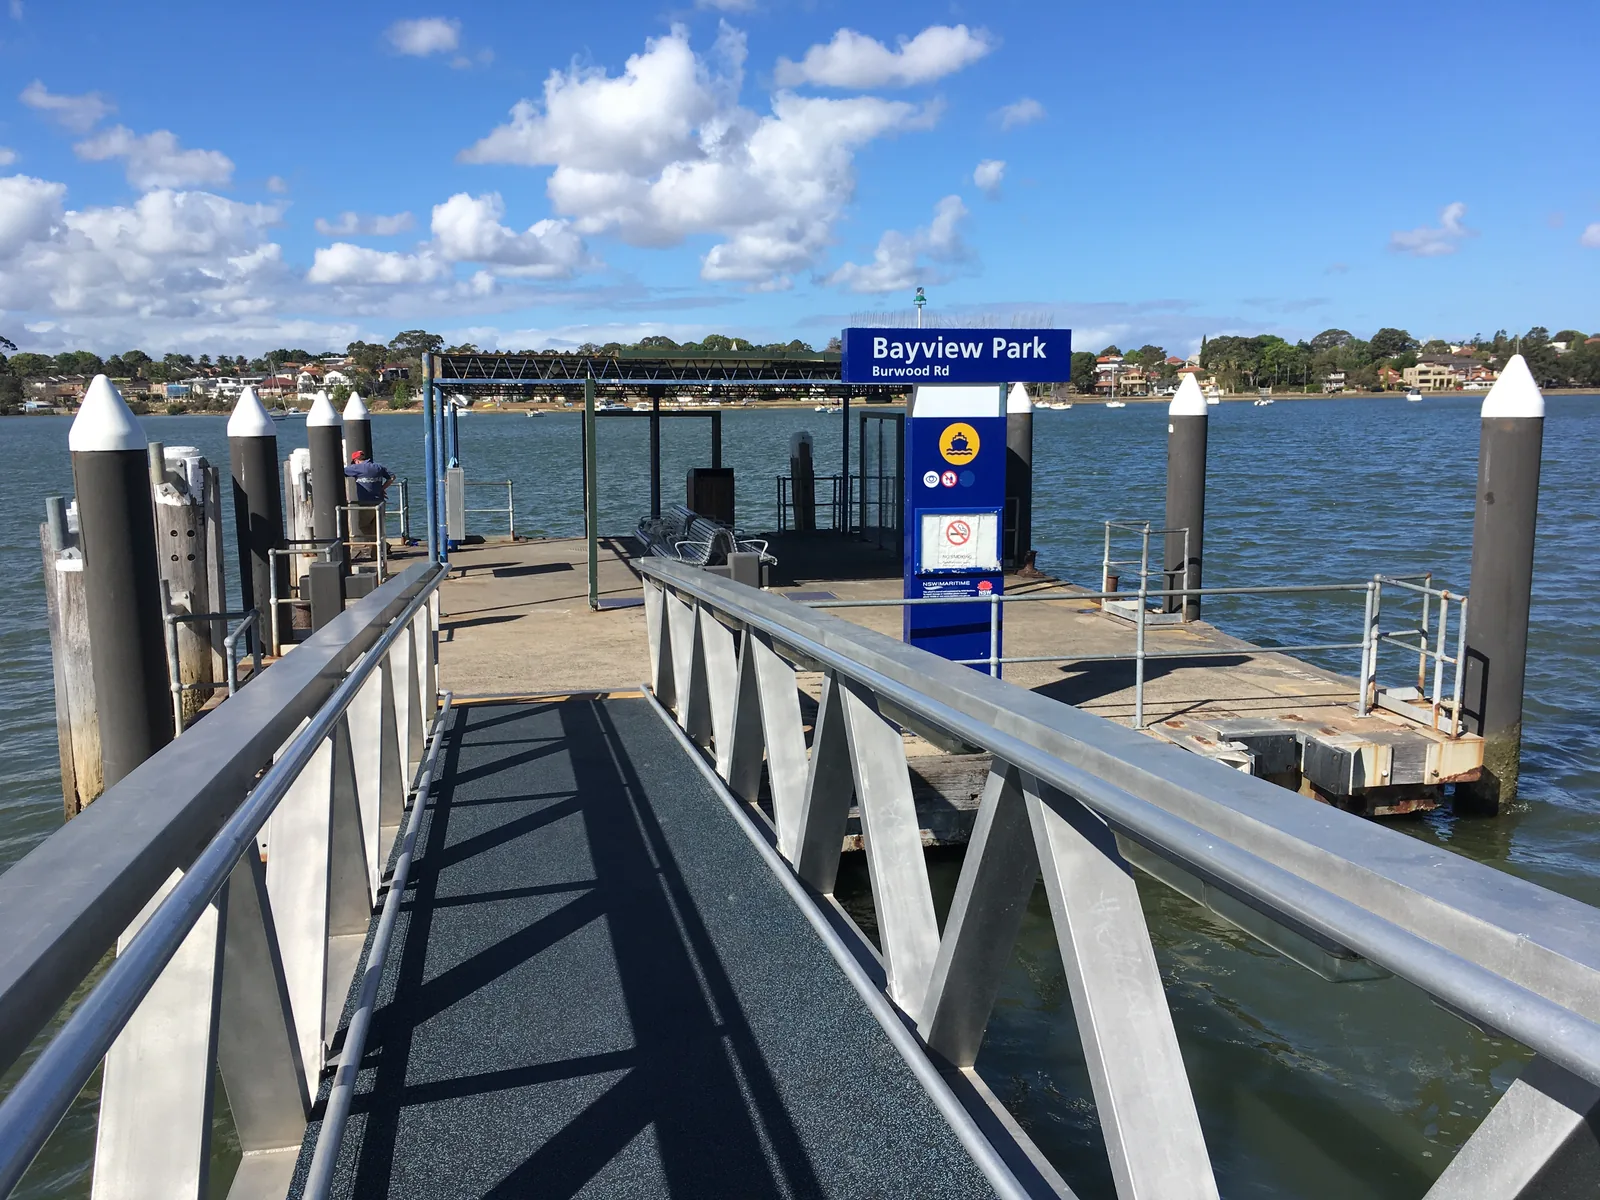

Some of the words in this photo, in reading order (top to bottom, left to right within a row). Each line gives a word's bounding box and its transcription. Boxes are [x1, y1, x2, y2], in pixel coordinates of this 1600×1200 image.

[873, 336, 983, 364] Bayview
[992, 336, 1047, 359] Park
[872, 365, 930, 376] Burwood
[934, 365, 950, 376] Rd
